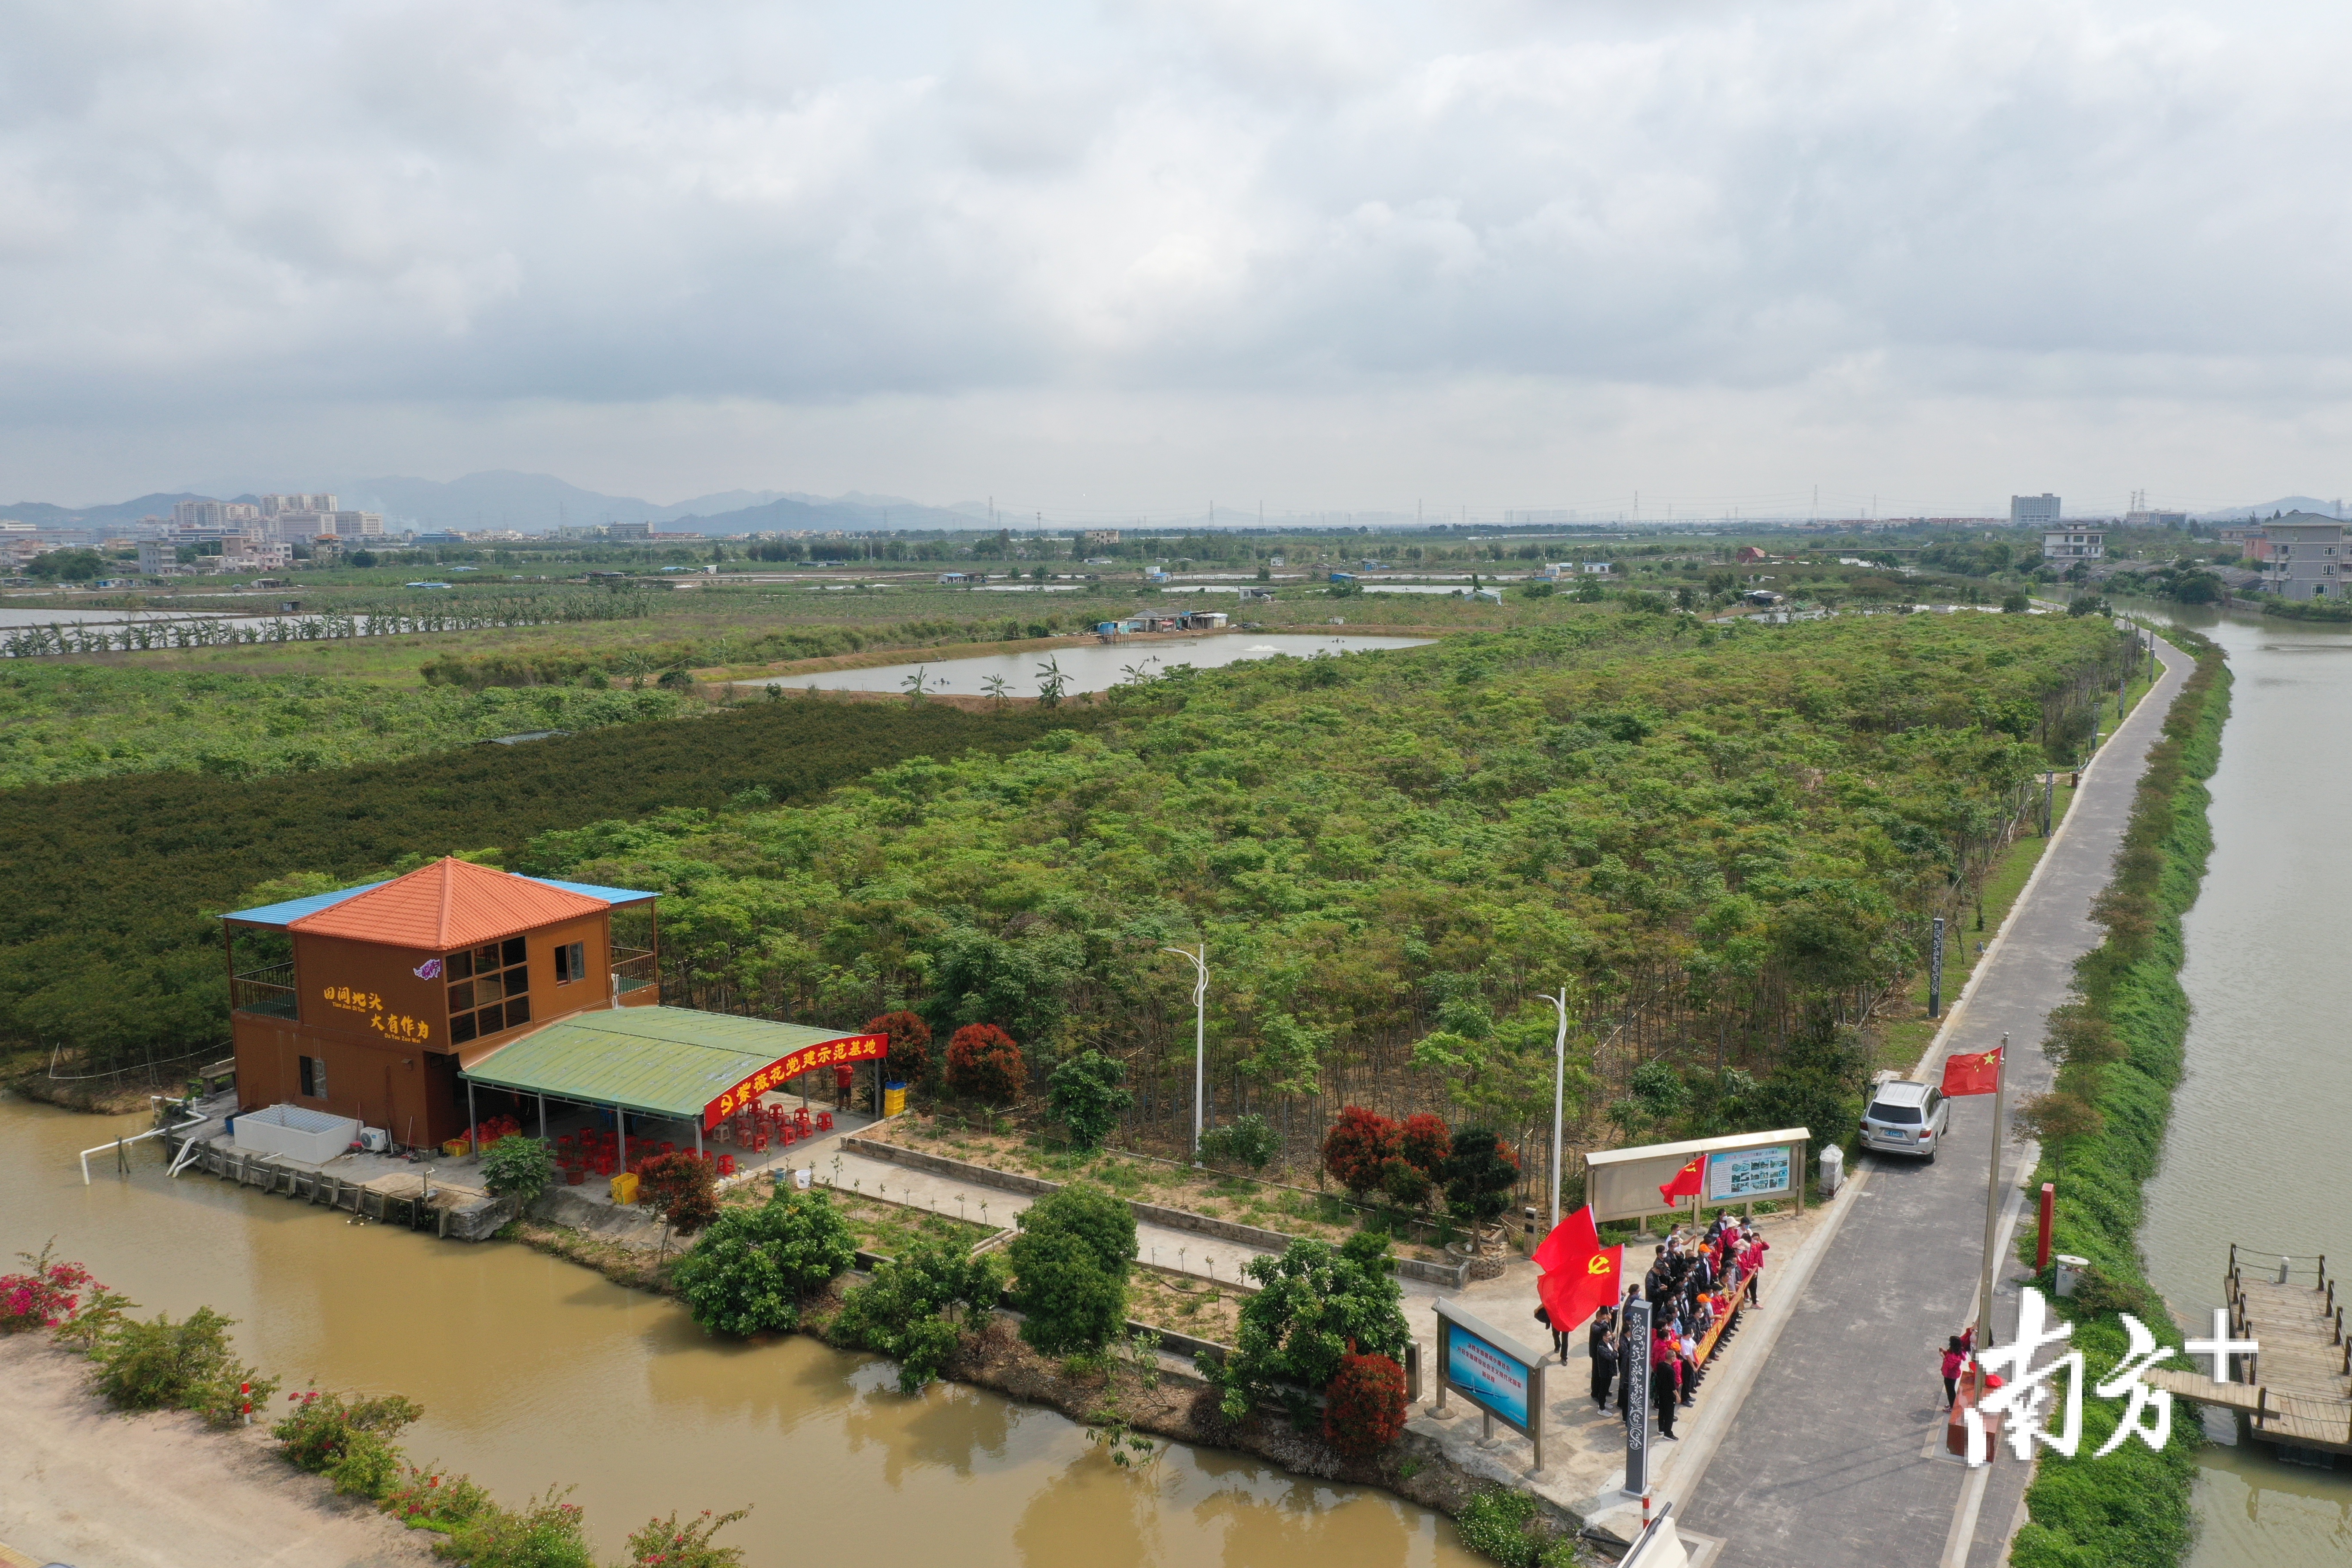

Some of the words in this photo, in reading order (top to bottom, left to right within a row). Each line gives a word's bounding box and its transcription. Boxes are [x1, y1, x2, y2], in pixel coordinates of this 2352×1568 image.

[324, 987, 383, 1011] 田间地头
[371, 1014, 429, 1039] 大有作为
[736, 1039, 876, 1105] 紫薇花党建示范基地
[1457, 1346, 1522, 1389] 开启全面建设社会主义现代化国家
[1467, 1342, 1511, 1372] 决胜全面建成小康社会
